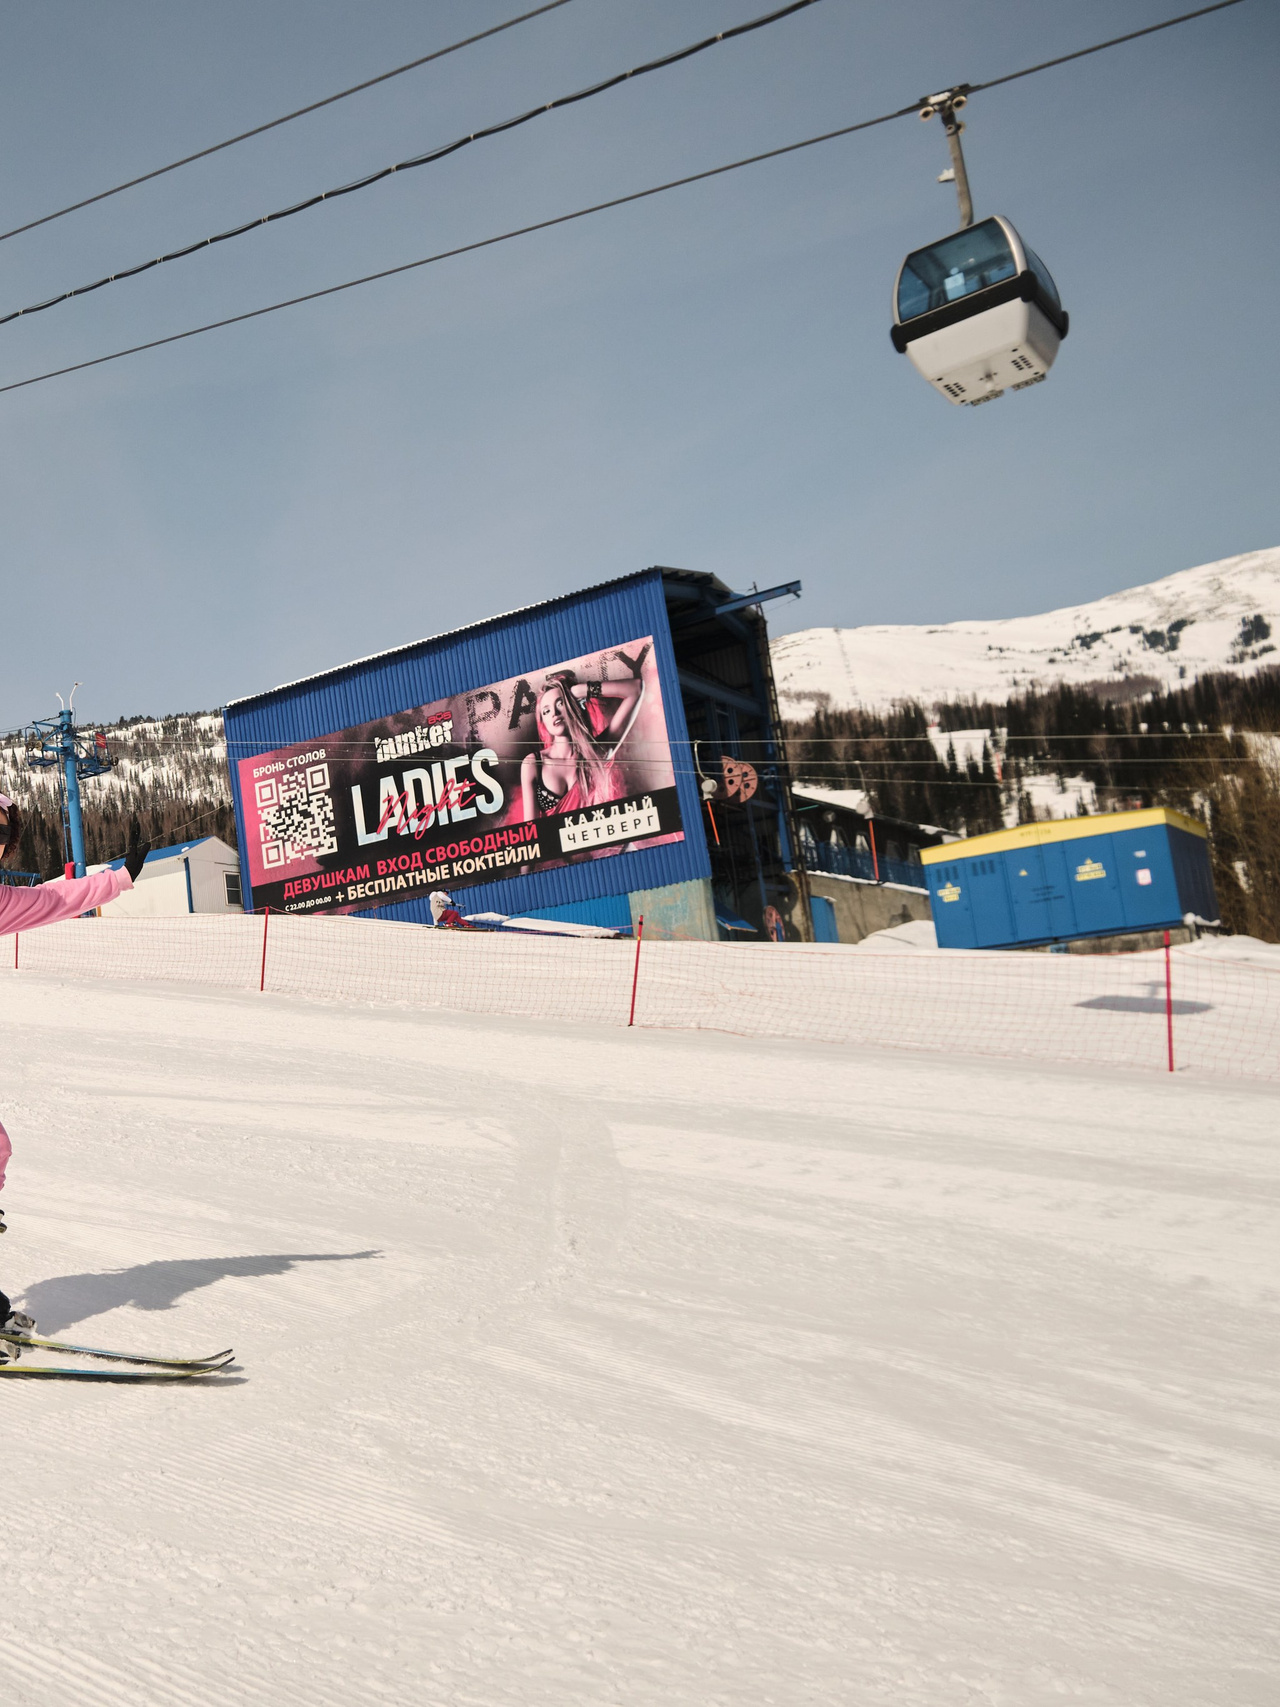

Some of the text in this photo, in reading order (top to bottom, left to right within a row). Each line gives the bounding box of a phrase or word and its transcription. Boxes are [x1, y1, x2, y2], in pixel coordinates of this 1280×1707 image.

[253, 748, 326, 778] БРОНЬ СТОЛОВ
[351, 748, 504, 847] LADIES
[376, 778, 477, 840] Night
[564, 795, 653, 828] КАЖДЫЙ
[567, 815, 654, 844] ЧЕТВЕРГ
[283, 821, 539, 900] ДЕВУШКАМ ВХОД СВОБОДНЫЙ
[347, 864, 450, 901] БЕСПЛАТНЫЕ
[452, 843, 542, 878] КОКТЕЙЛИ
[306, 899, 315, 909] ДО
